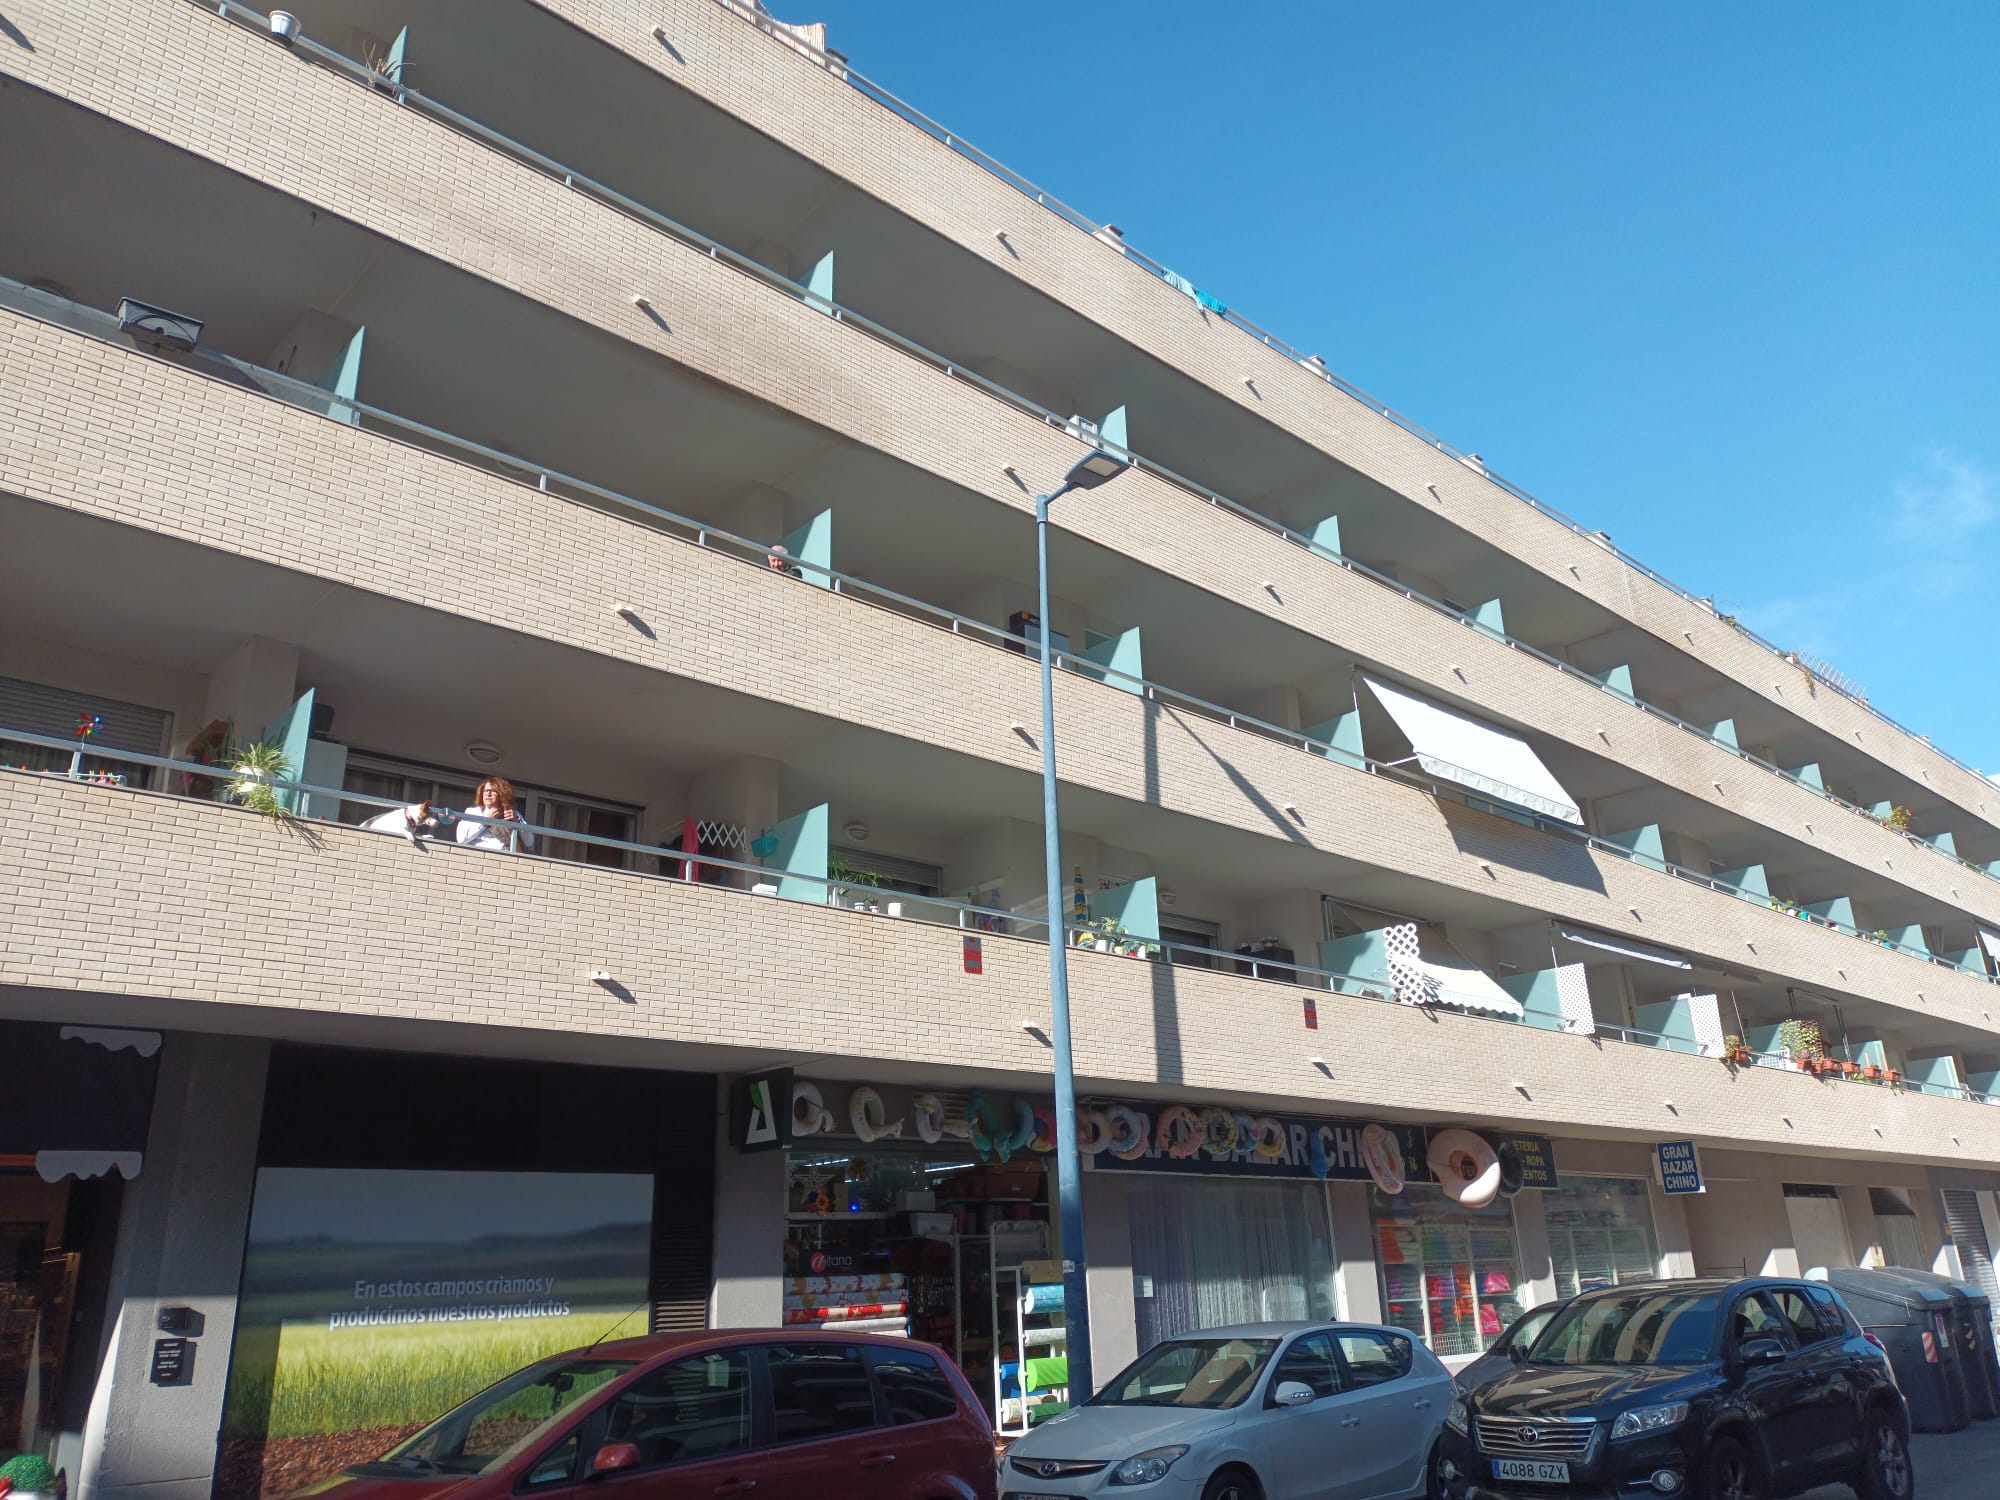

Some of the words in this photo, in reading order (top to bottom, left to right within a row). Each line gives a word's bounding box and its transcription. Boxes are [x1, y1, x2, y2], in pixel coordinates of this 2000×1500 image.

[1662, 1145, 1690, 1159] GRAN
[1662, 1159, 1696, 1174] BAZAR
[1523, 1169, 1548, 1181] ENTOS
[1665, 1174, 1697, 1189] CHINO
[354, 1280, 376, 1299] En
[378, 1279, 421, 1298] estos
[424, 1279, 482, 1299] campos
[486, 1275, 542, 1294] criamos
[541, 1277, 555, 1295] y
[329, 1304, 426, 1331] producimos
[428, 1303, 496, 1323] nuestros
[498, 1299, 570, 1322] productos
[1502, 1462, 1535, 1478] 4088
[1539, 1464, 1565, 1480] GZX
